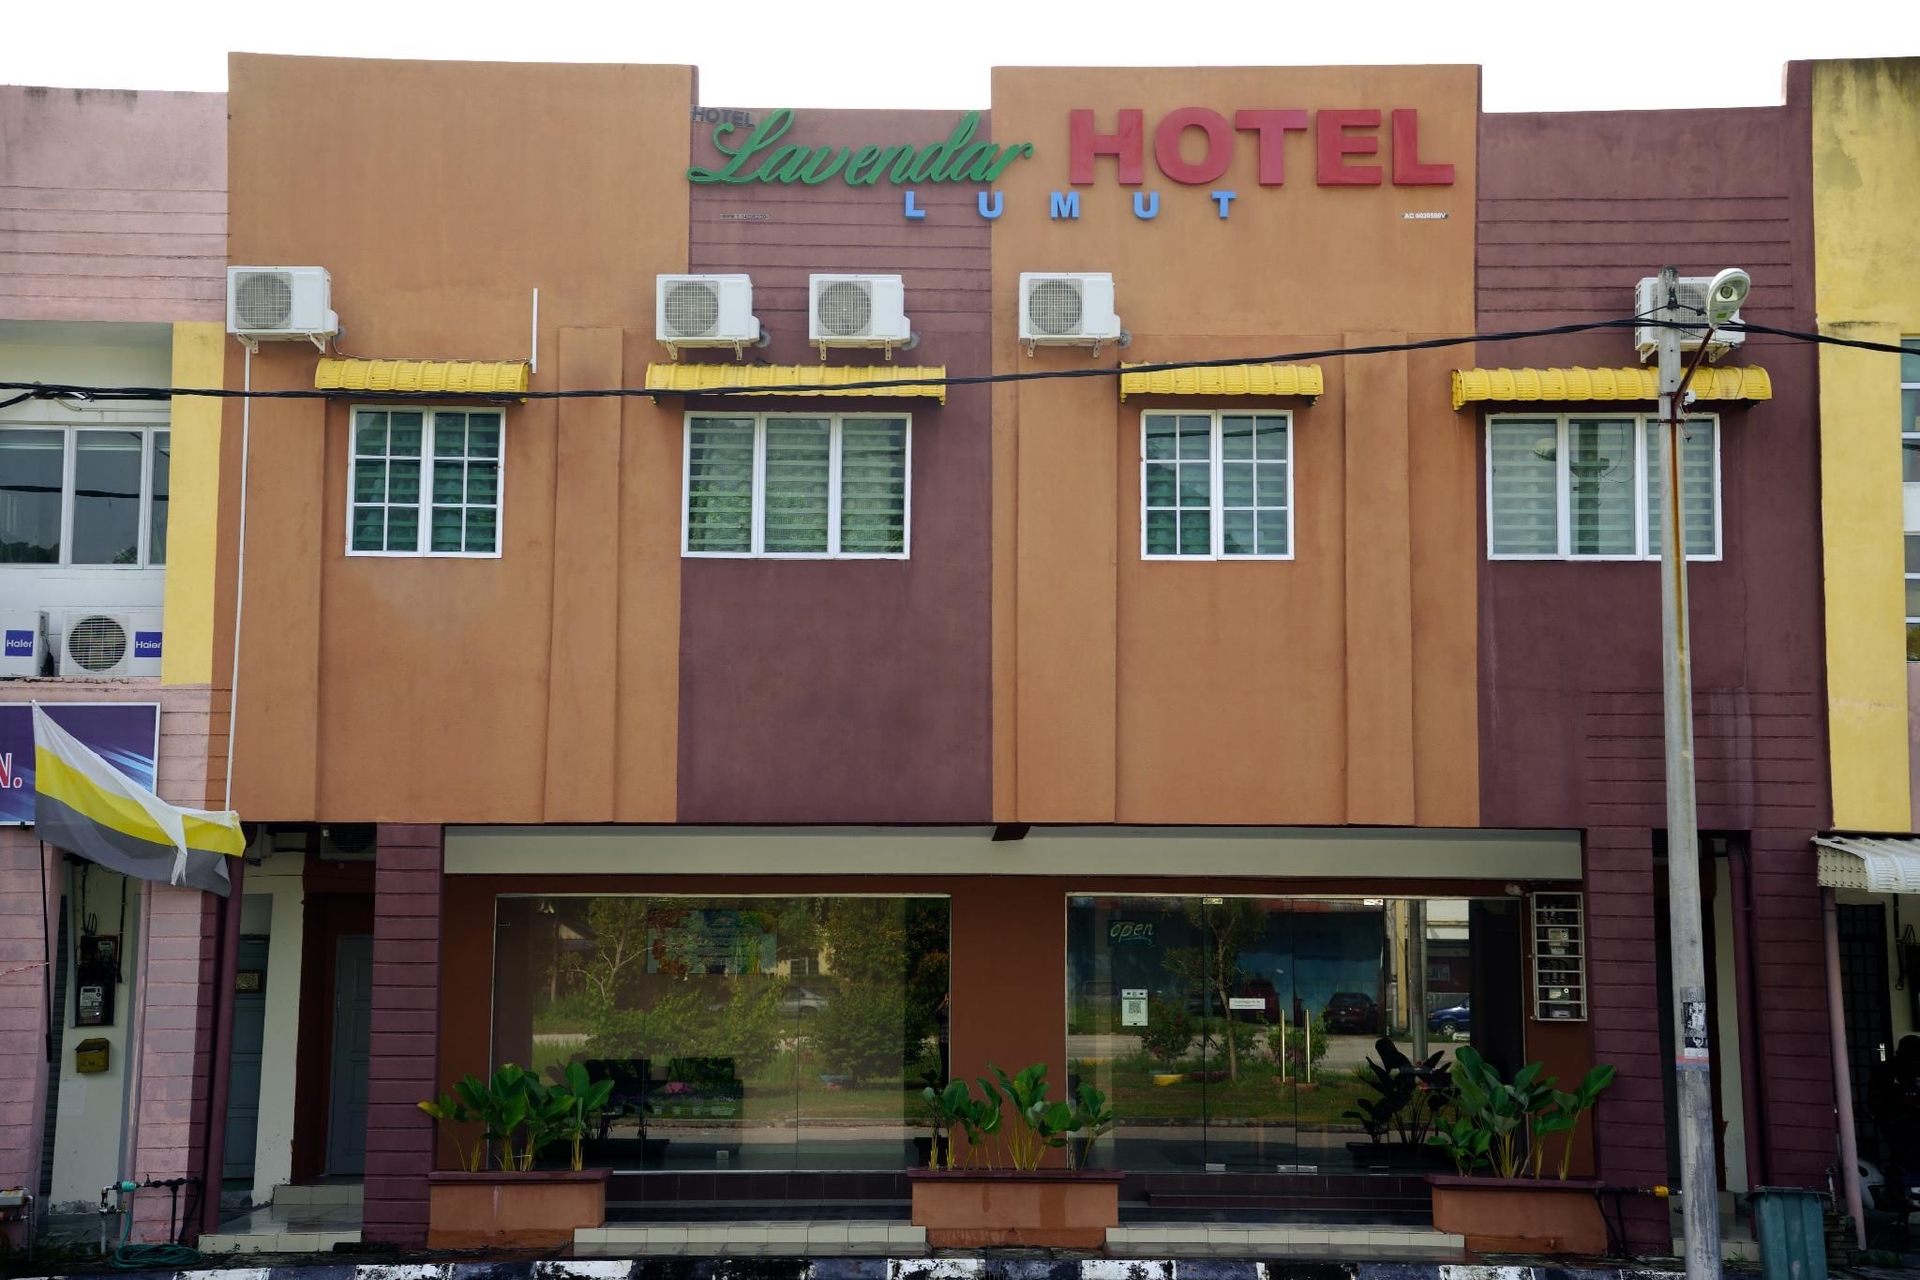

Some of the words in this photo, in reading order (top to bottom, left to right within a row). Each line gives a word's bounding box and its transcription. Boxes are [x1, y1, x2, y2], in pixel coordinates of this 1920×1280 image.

[692, 105, 755, 128] HOTEL
[687, 108, 1035, 186] Lavendar
[1070, 107, 1455, 187] HOTEL
[6, 639, 33, 648] Haier
[135, 640, 162, 649] Haier
[1110, 922, 1155, 944] open
